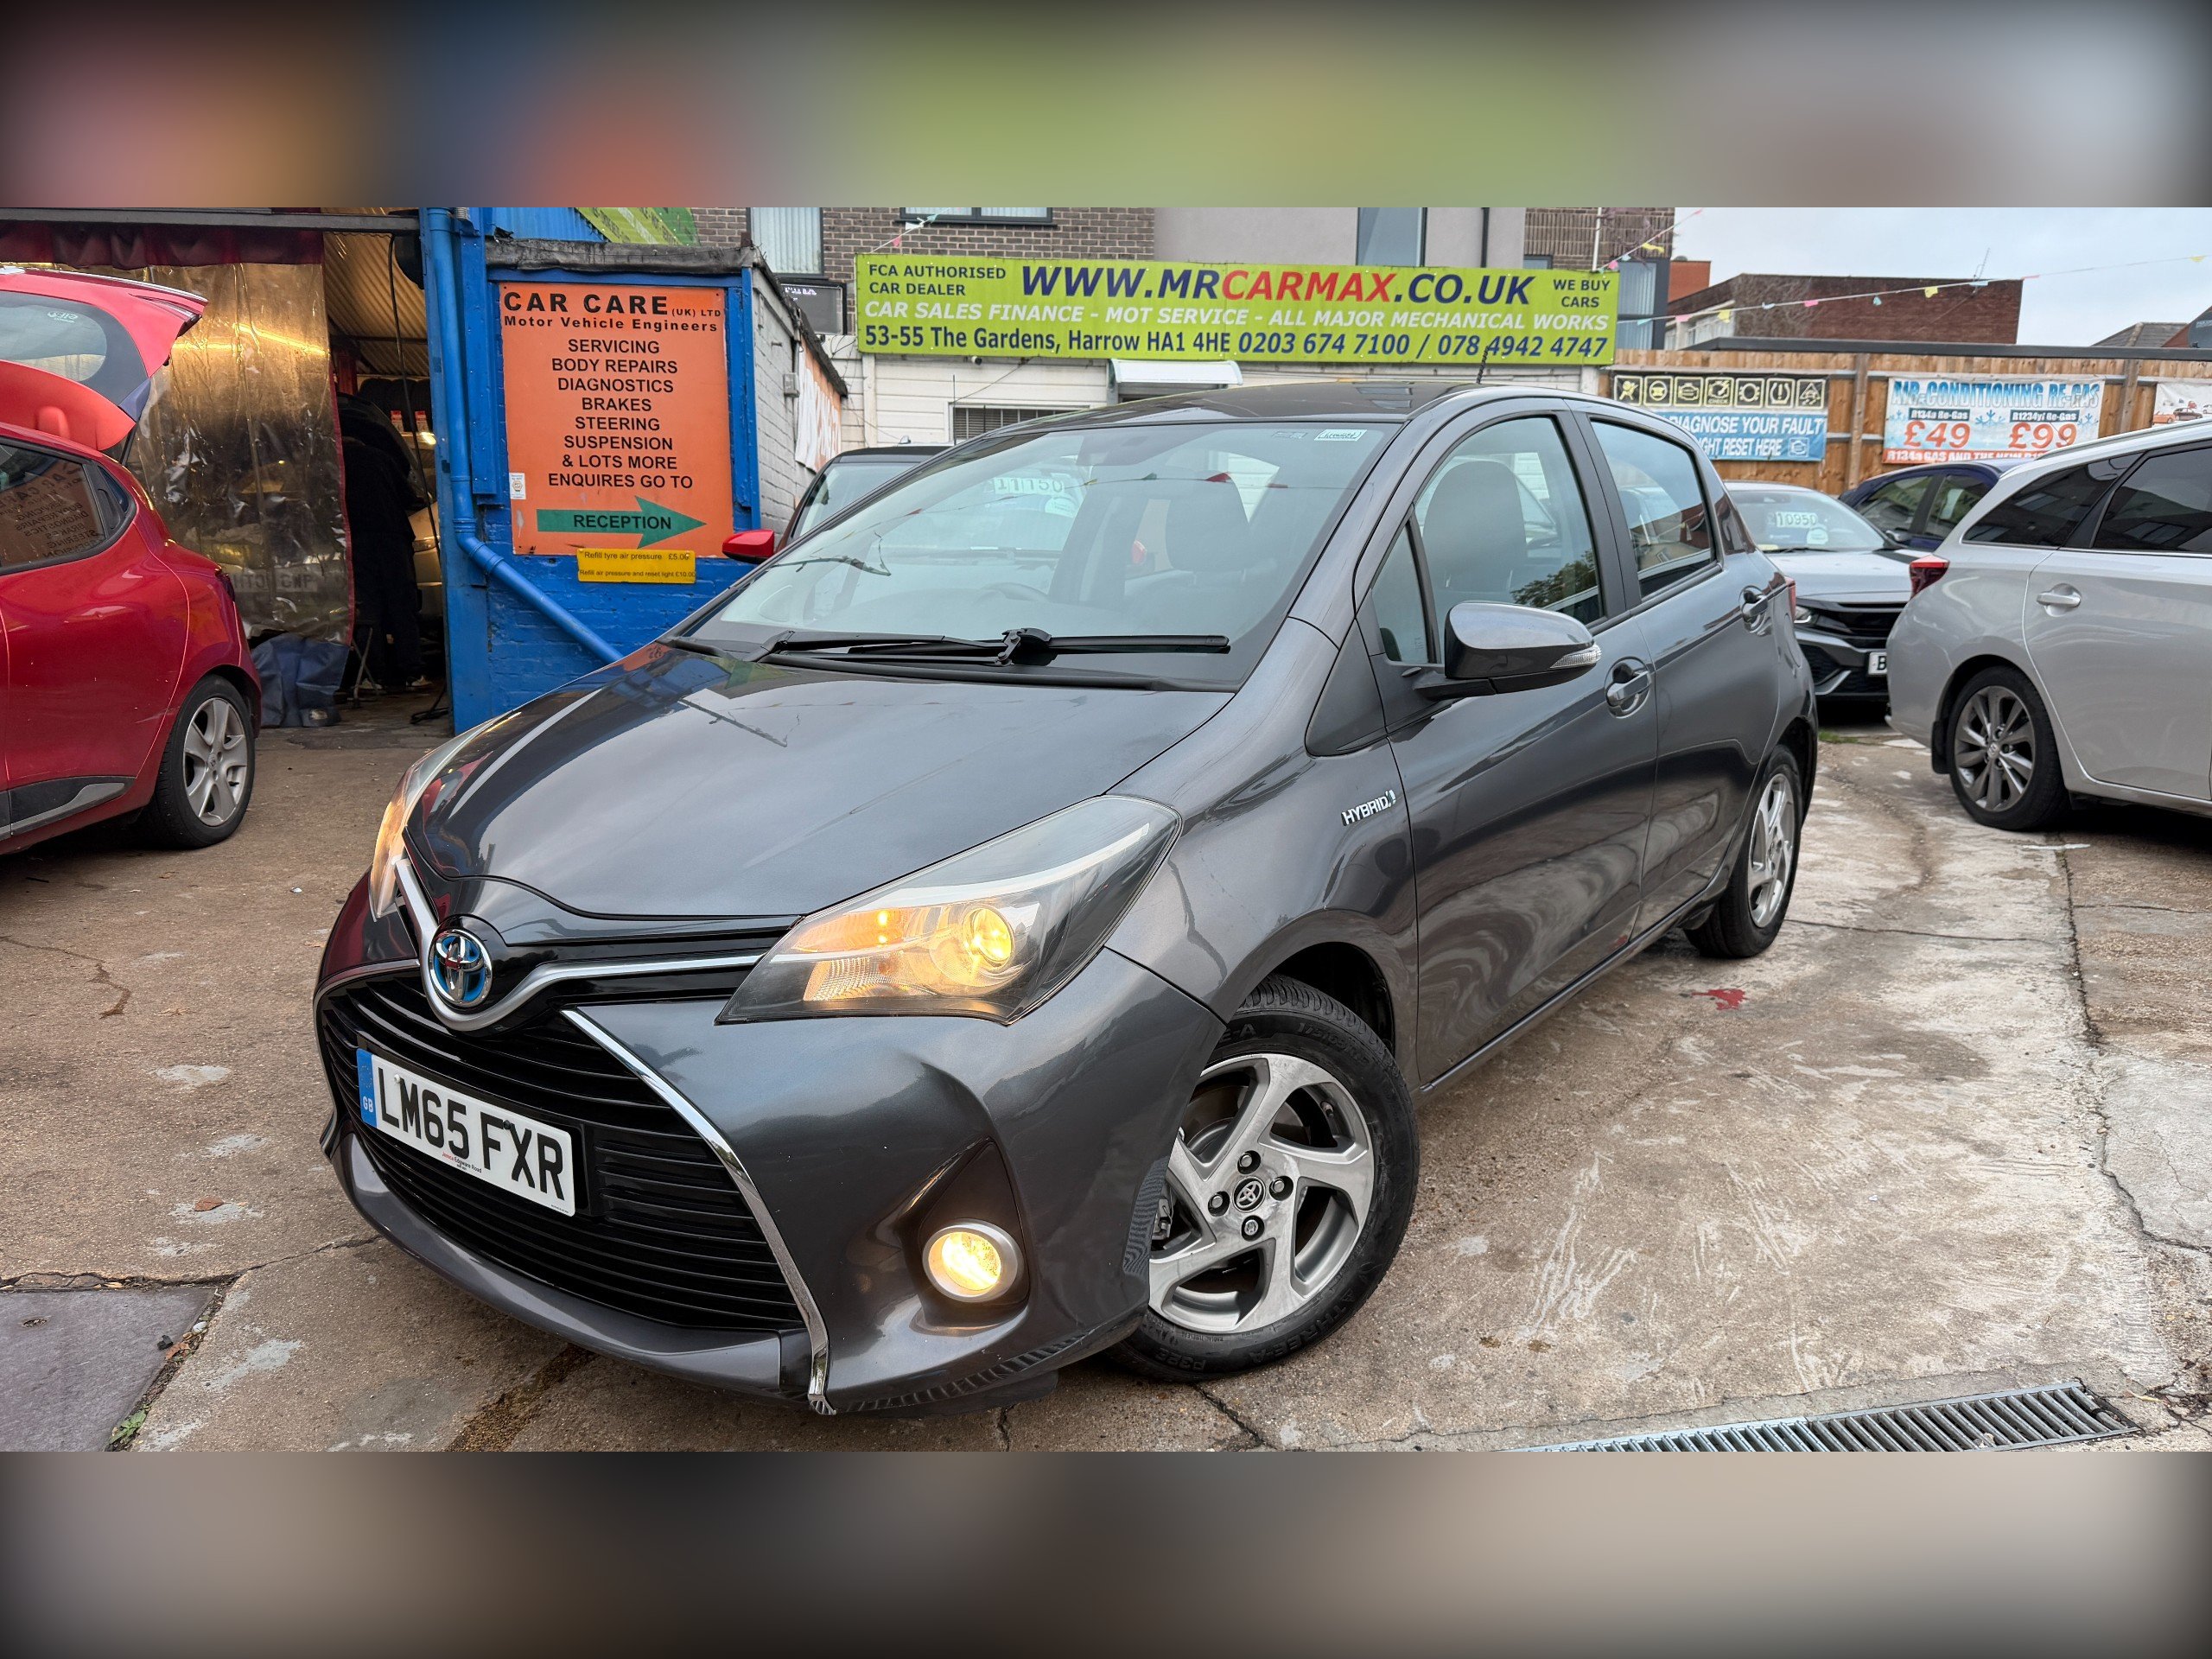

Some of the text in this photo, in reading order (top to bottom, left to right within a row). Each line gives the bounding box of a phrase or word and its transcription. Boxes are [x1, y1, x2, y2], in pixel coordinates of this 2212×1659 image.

[869, 264, 1006, 279] FCA AUTHORISED
[869, 283, 966, 296] CAR DEALER
[1022, 266, 1535, 305] WWW.MRCARMAX.CO.UK
[1553, 279, 1611, 292] WE BUY
[504, 292, 721, 318] CAR CARE (UK) LTD
[1561, 296, 1599, 308] CARS
[504, 315, 718, 332] Motor Vehicle Engineers
[865, 301, 908, 318] CAR
[914, 302, 982, 320] SALES
[988, 304, 1084, 322] FINANCE
[1105, 306, 1152, 323] MOT
[1157, 307, 1249, 325] SERVICE
[1268, 309, 1306, 326] ALL
[1313, 309, 1385, 327] MAJOR
[1390, 311, 1525, 329] MECHANICAL
[1533, 314, 1609, 331] WORKS
[568, 339, 659, 353] SERVICING
[866, 325, 924, 346] 53-55
[931, 326, 967, 348] The
[974, 327, 1060, 354] Gardens,
[1069, 329, 1140, 351] Harrow
[1147, 331, 1185, 352] HA1
[1192, 332, 1230, 353] 4HE
[1238, 332, 1295, 354] 0203
[1303, 333, 1345, 354] 674
[1353, 334, 1410, 355] 7100
[1438, 334, 1480, 356] 078
[1487, 335, 1543, 357] 4942
[1550, 337, 1608, 358] 4747
[552, 358, 677, 373] BODY REPAIRS
[558, 378, 674, 393] DIAGNOSTICS
[1891, 380, 2101, 409] AIR-CONDITIONING RE-GAS
[582, 397, 652, 411] BRAKES
[575, 416, 660, 431] STEERING
[1742, 416, 1778, 435] YOUR
[1782, 417, 1823, 435] FAULT
[1904, 421, 1971, 448] £49
[2009, 423, 2077, 448] £99
[564, 435, 673, 450] SUSPENSION
[1722, 437, 1755, 456] RESET
[1755, 438, 1783, 456] HERE
[563, 454, 677, 469] & LOTS MORE
[1923, 451, 1947, 461] GAS
[549, 474, 693, 489] ENQUIRES GO TO
[574, 514, 671, 529] RECEPTION
[605, 552, 618, 561] tyre
[1341, 795, 1391, 825] HYBRID
[363, 1096, 374, 1113] GB
[378, 1067, 565, 1201] LM65 FXR
[454, 1156, 472, 1169] Edgware
[472, 1164, 482, 1173] Road
